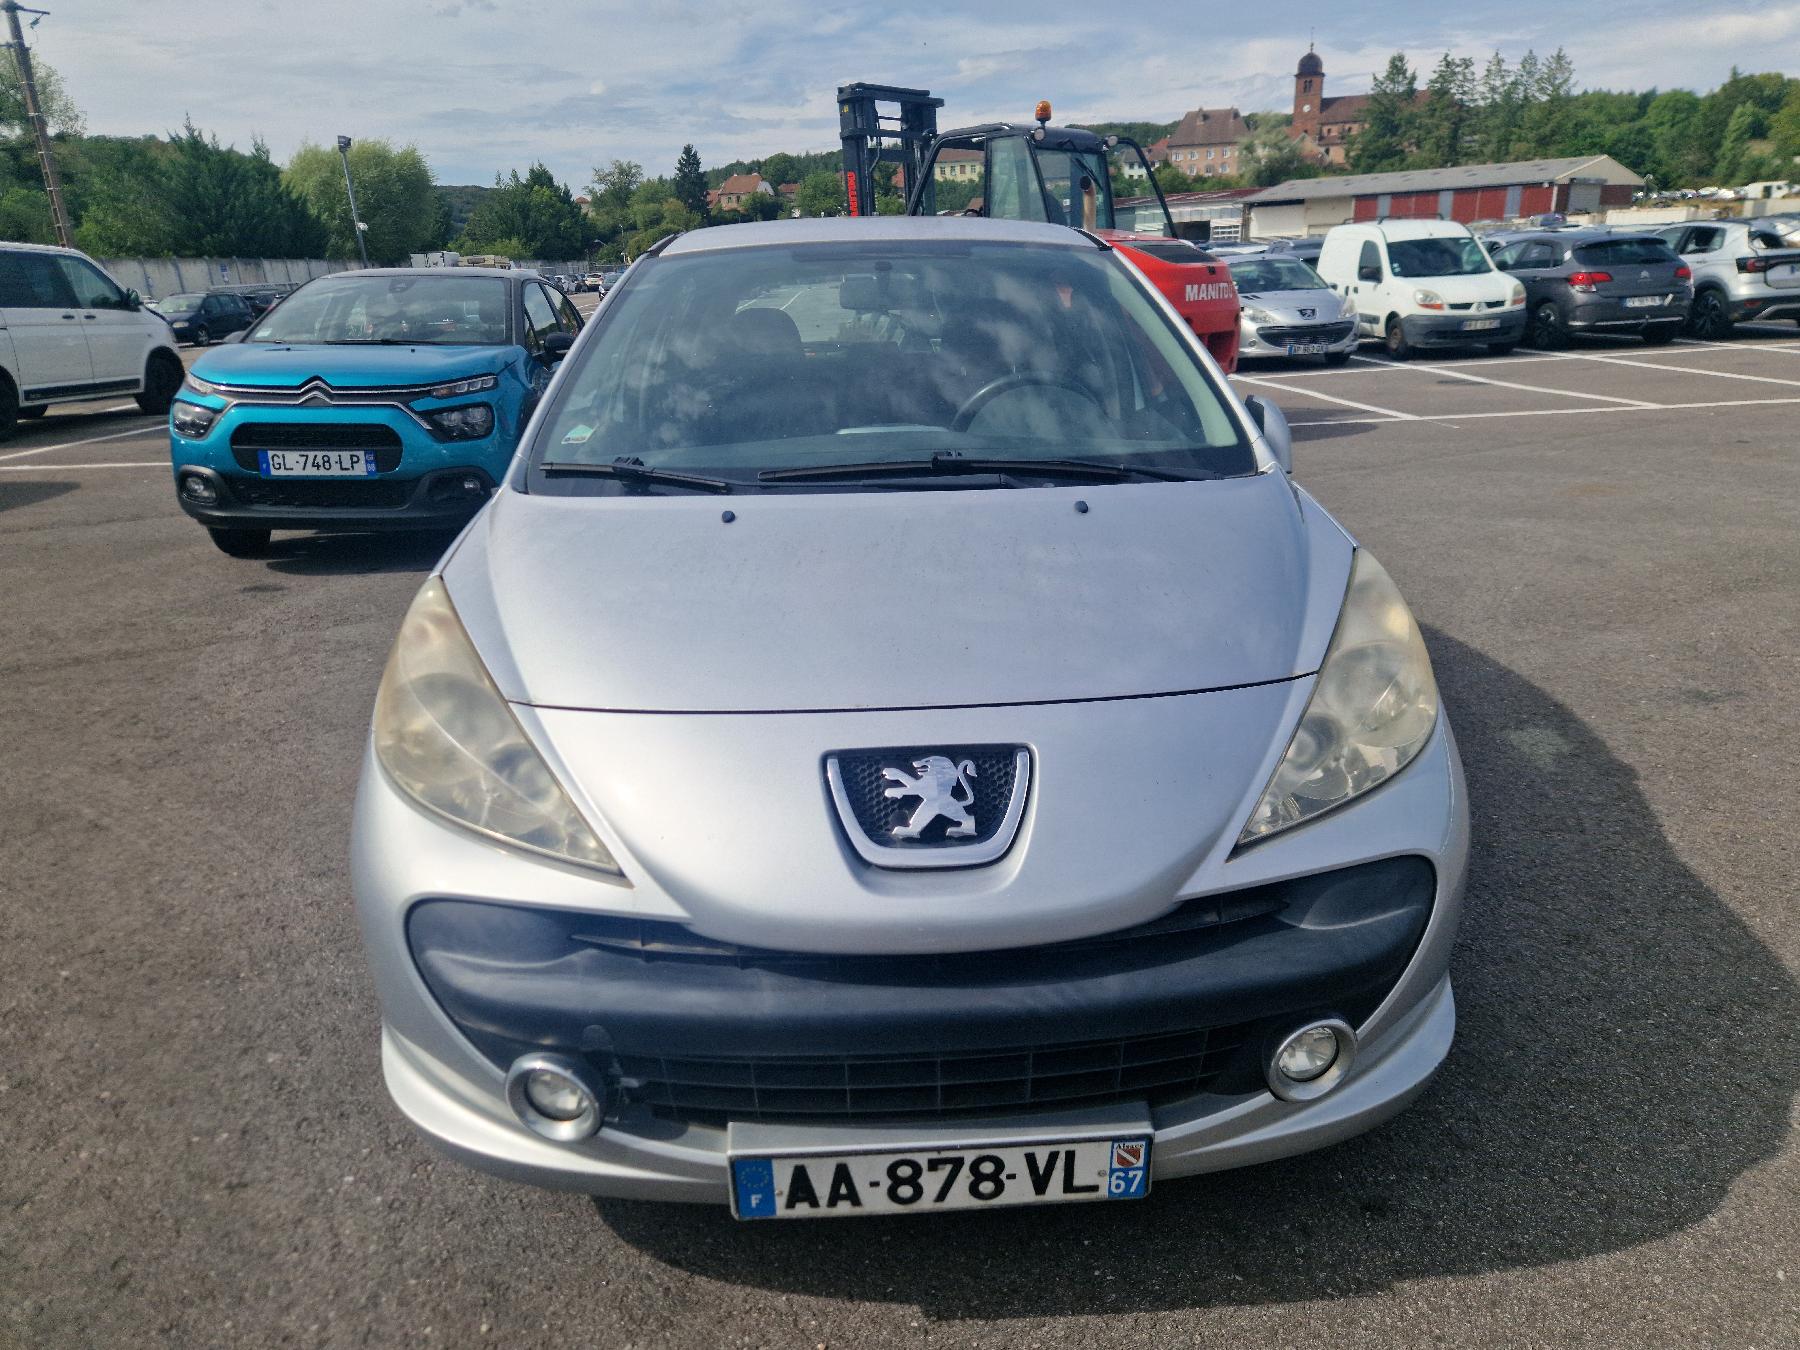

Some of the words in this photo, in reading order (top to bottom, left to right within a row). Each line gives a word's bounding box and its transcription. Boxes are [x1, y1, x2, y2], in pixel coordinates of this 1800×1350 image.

[1185, 282, 1233, 302] MANITOU
[271, 453, 360, 471] GL-748-LP
[784, 1149, 1100, 1210] AA-878-VL
[1110, 1170, 1143, 1193] 67
[751, 1193, 762, 1209] F
